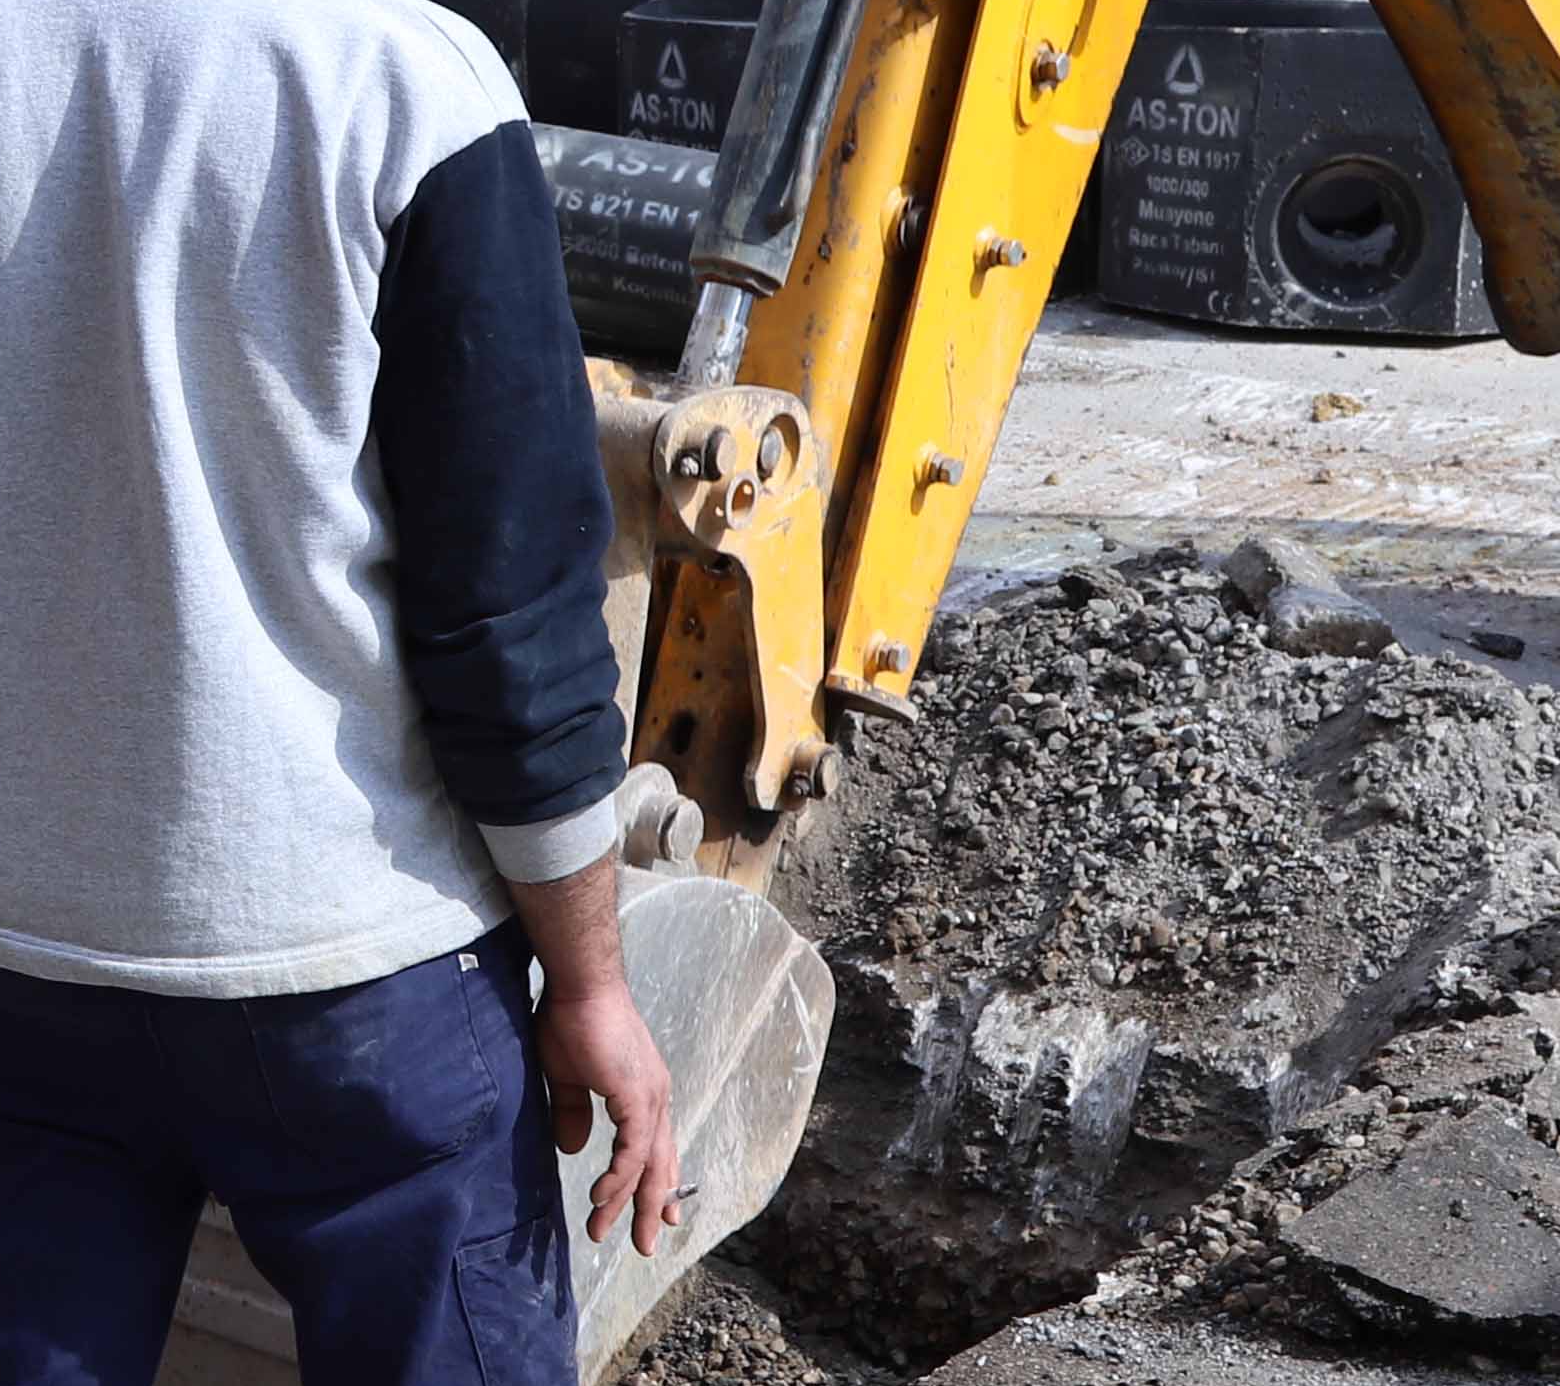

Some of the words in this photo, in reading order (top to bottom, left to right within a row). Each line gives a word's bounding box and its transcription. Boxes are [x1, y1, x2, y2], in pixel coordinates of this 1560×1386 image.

[629, 89, 716, 133] AS-TON
[1128, 97, 1241, 139] AS-TON
[1151, 144, 1173, 165] TS
[1177, 147, 1200, 167] EN
[1205, 149, 1241, 171] 1917
[552, 185, 584, 213] TS
[589, 192, 635, 218] 821
